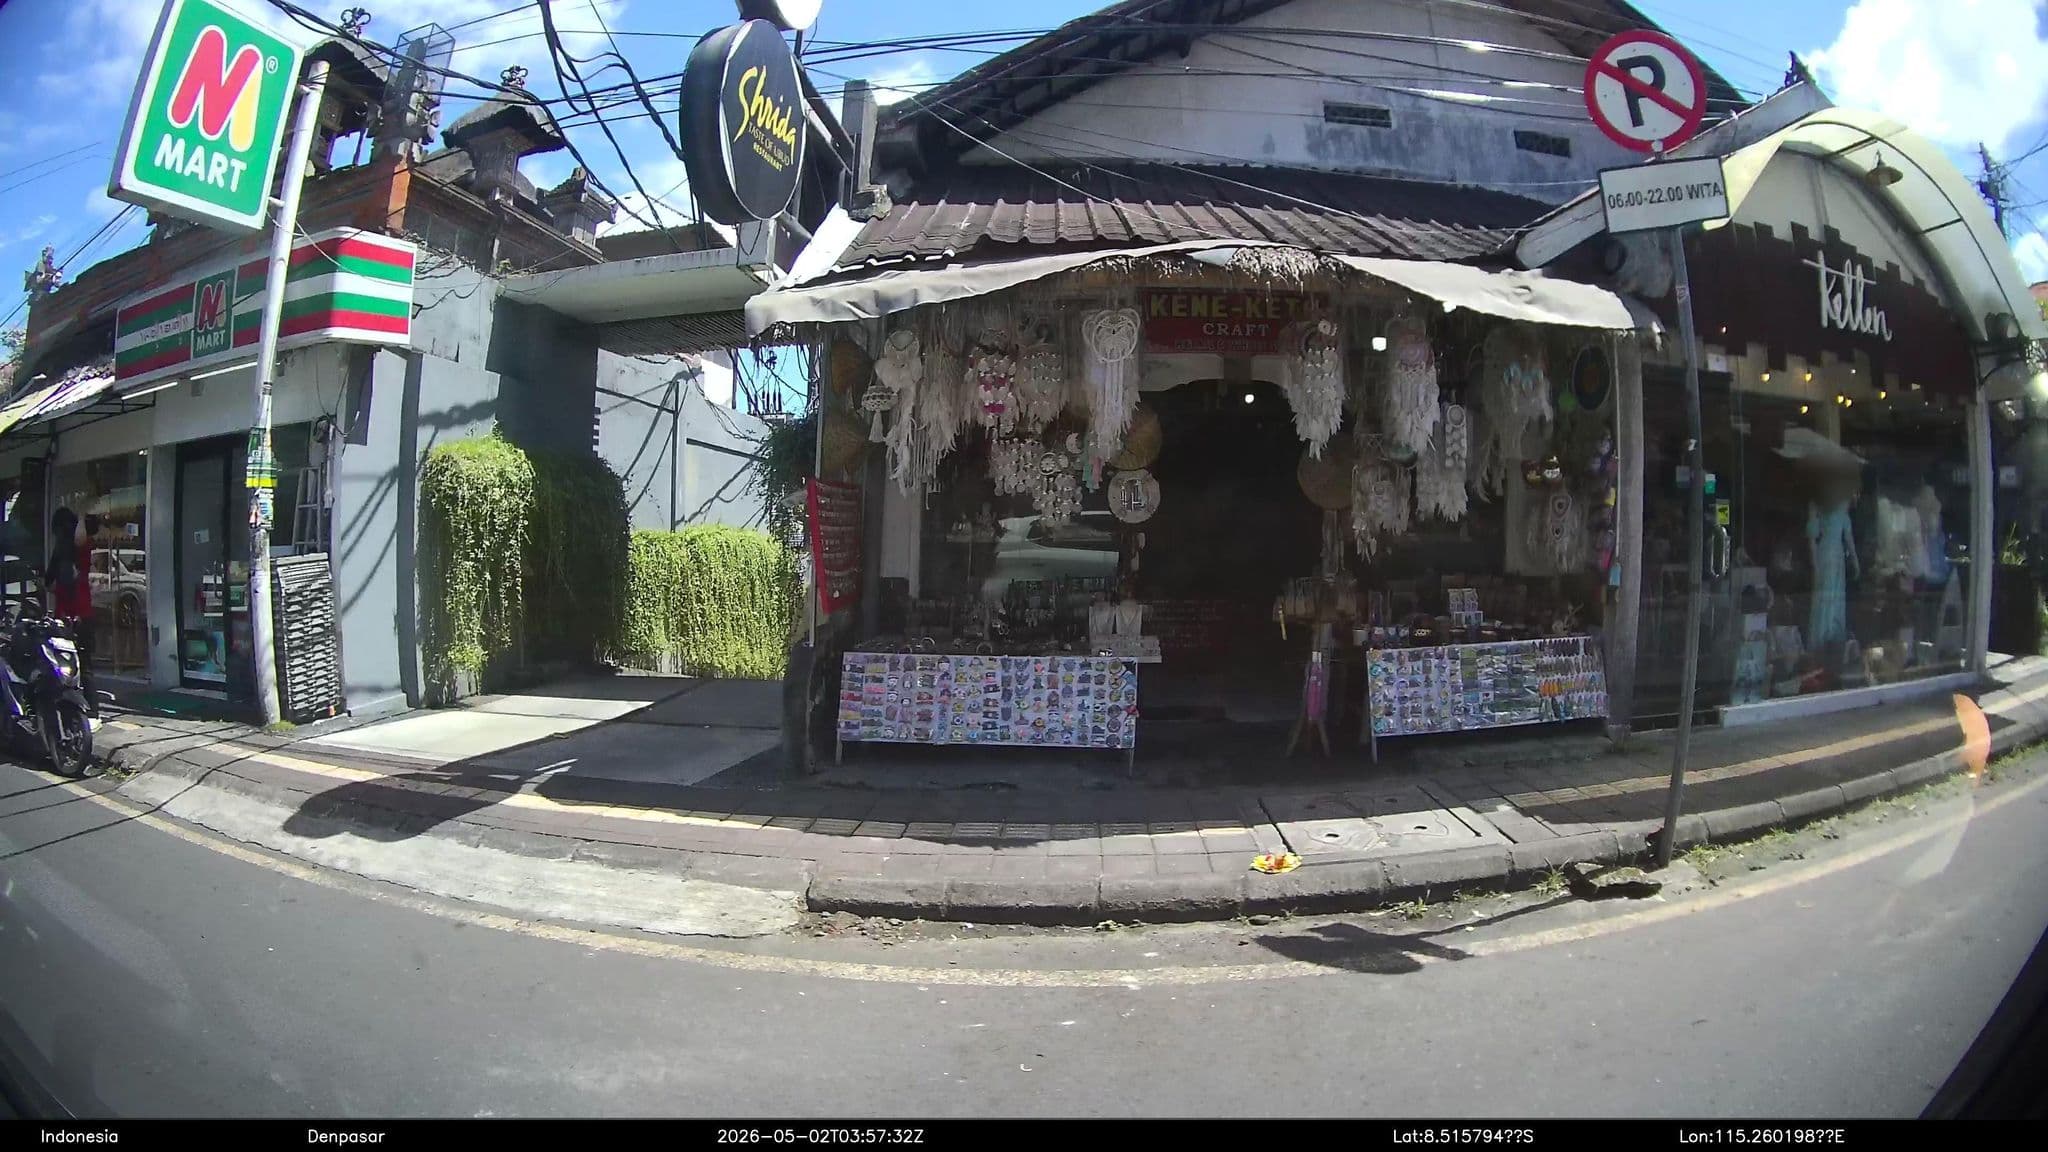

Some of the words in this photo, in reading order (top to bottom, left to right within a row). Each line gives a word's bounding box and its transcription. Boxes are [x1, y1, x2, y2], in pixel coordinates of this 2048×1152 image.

[1616, 55, 1666, 128] P
[733, 65, 797, 165] Shrida
[748, 121, 765, 144] TASTE
[154, 133, 248, 193] MART
[196, 329, 226, 351] MART
[1203, 322, 1269, 337] CRAFT
